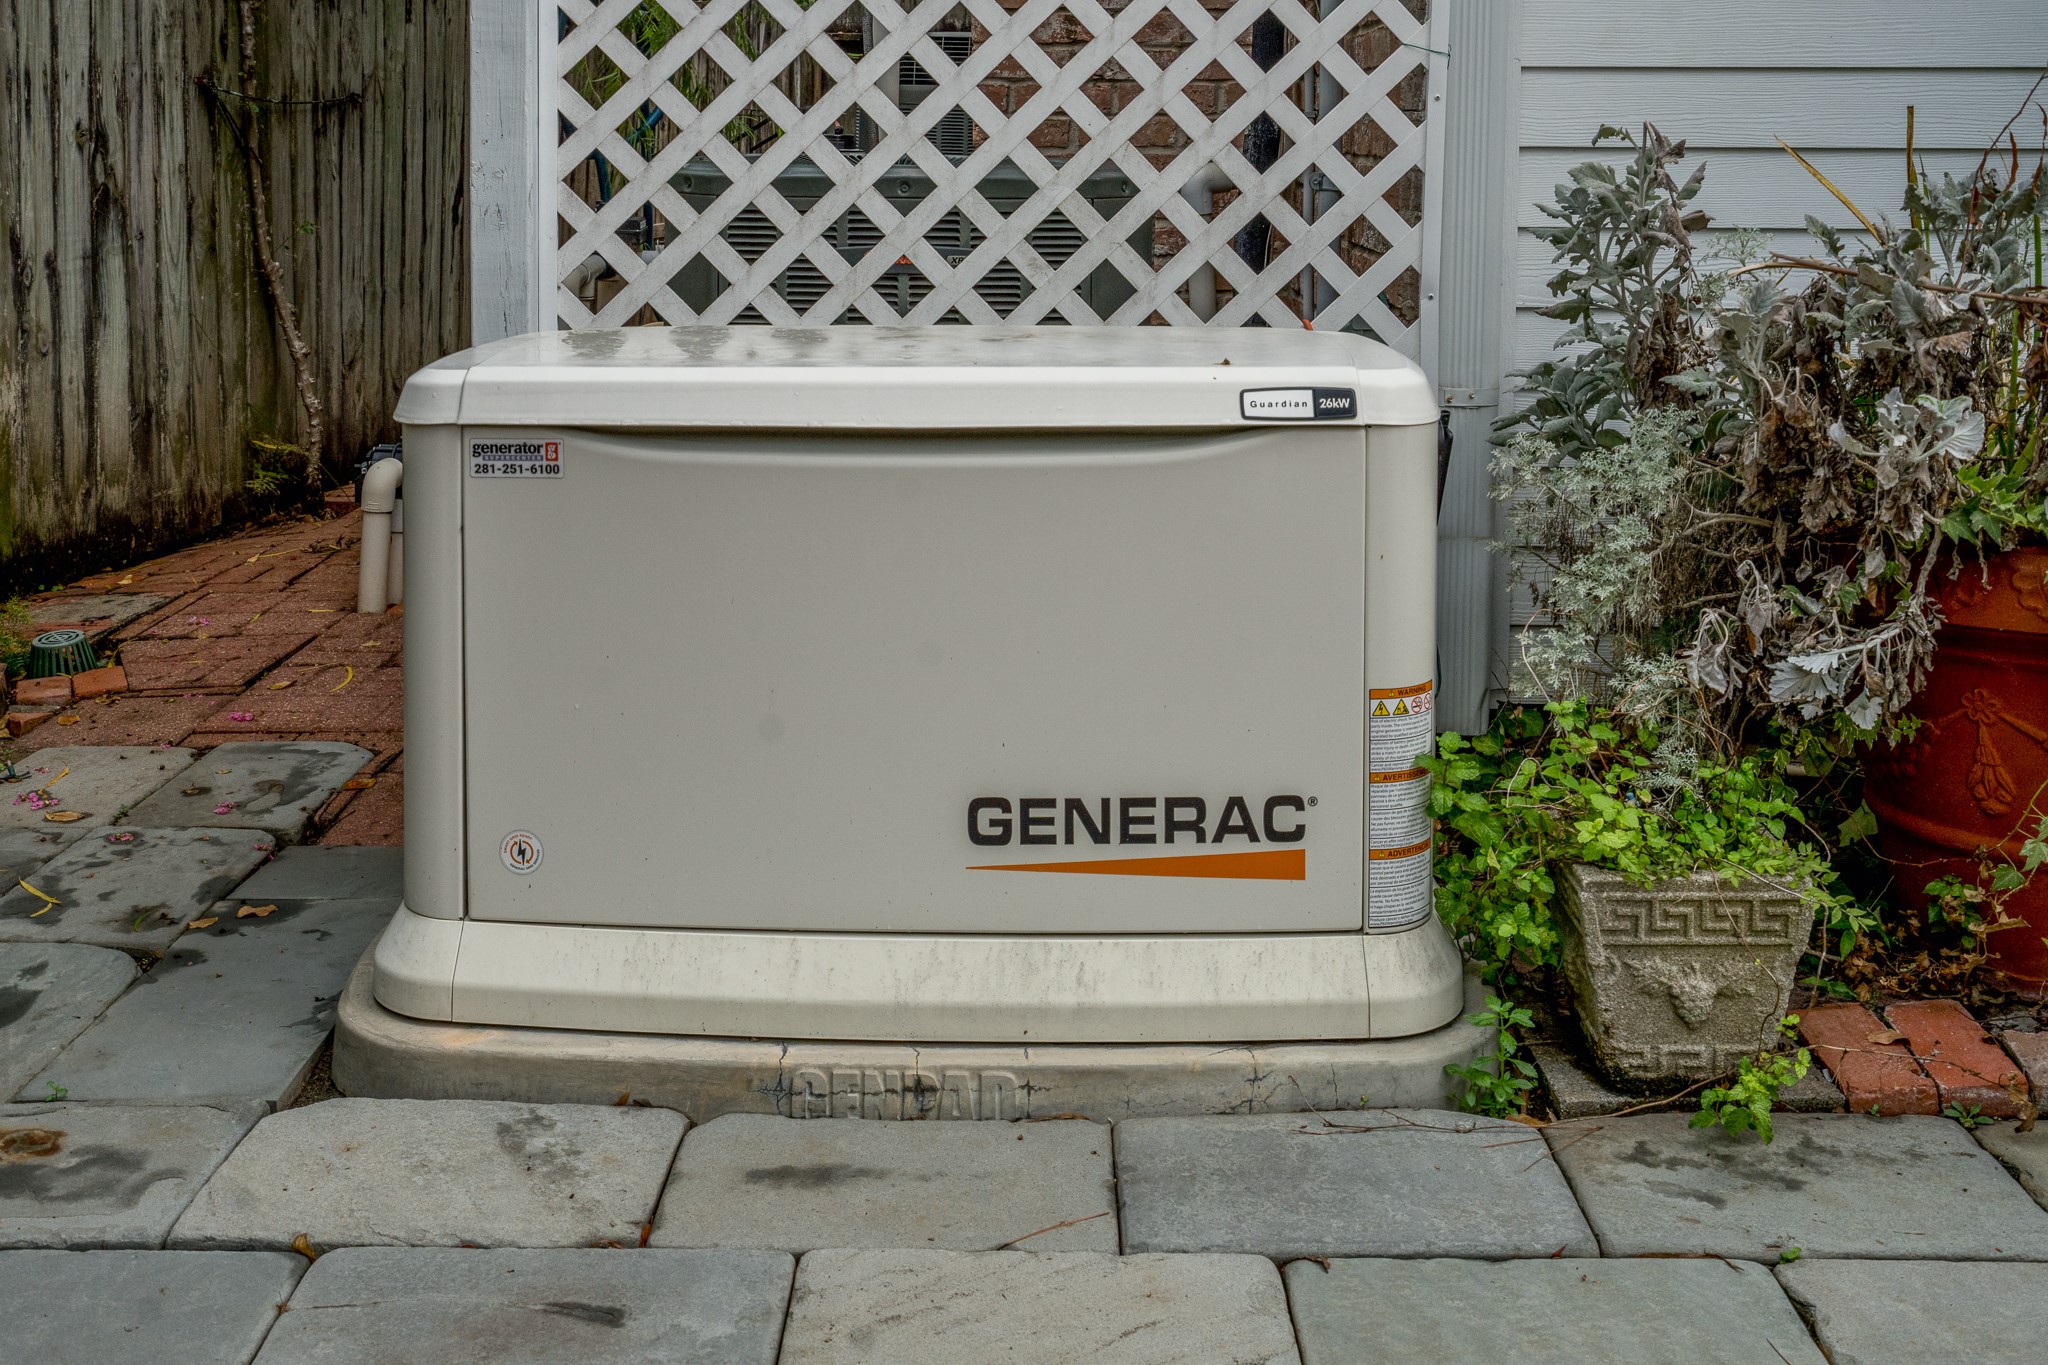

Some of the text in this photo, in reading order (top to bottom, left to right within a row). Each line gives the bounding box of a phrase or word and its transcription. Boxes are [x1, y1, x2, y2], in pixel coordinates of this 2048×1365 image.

[1250, 398, 1350, 408] Guardian 26kW
[472, 442, 543, 458] generator
[474, 464, 560, 474] 281-251-6100
[1398, 685, 1426, 696] WARNING
